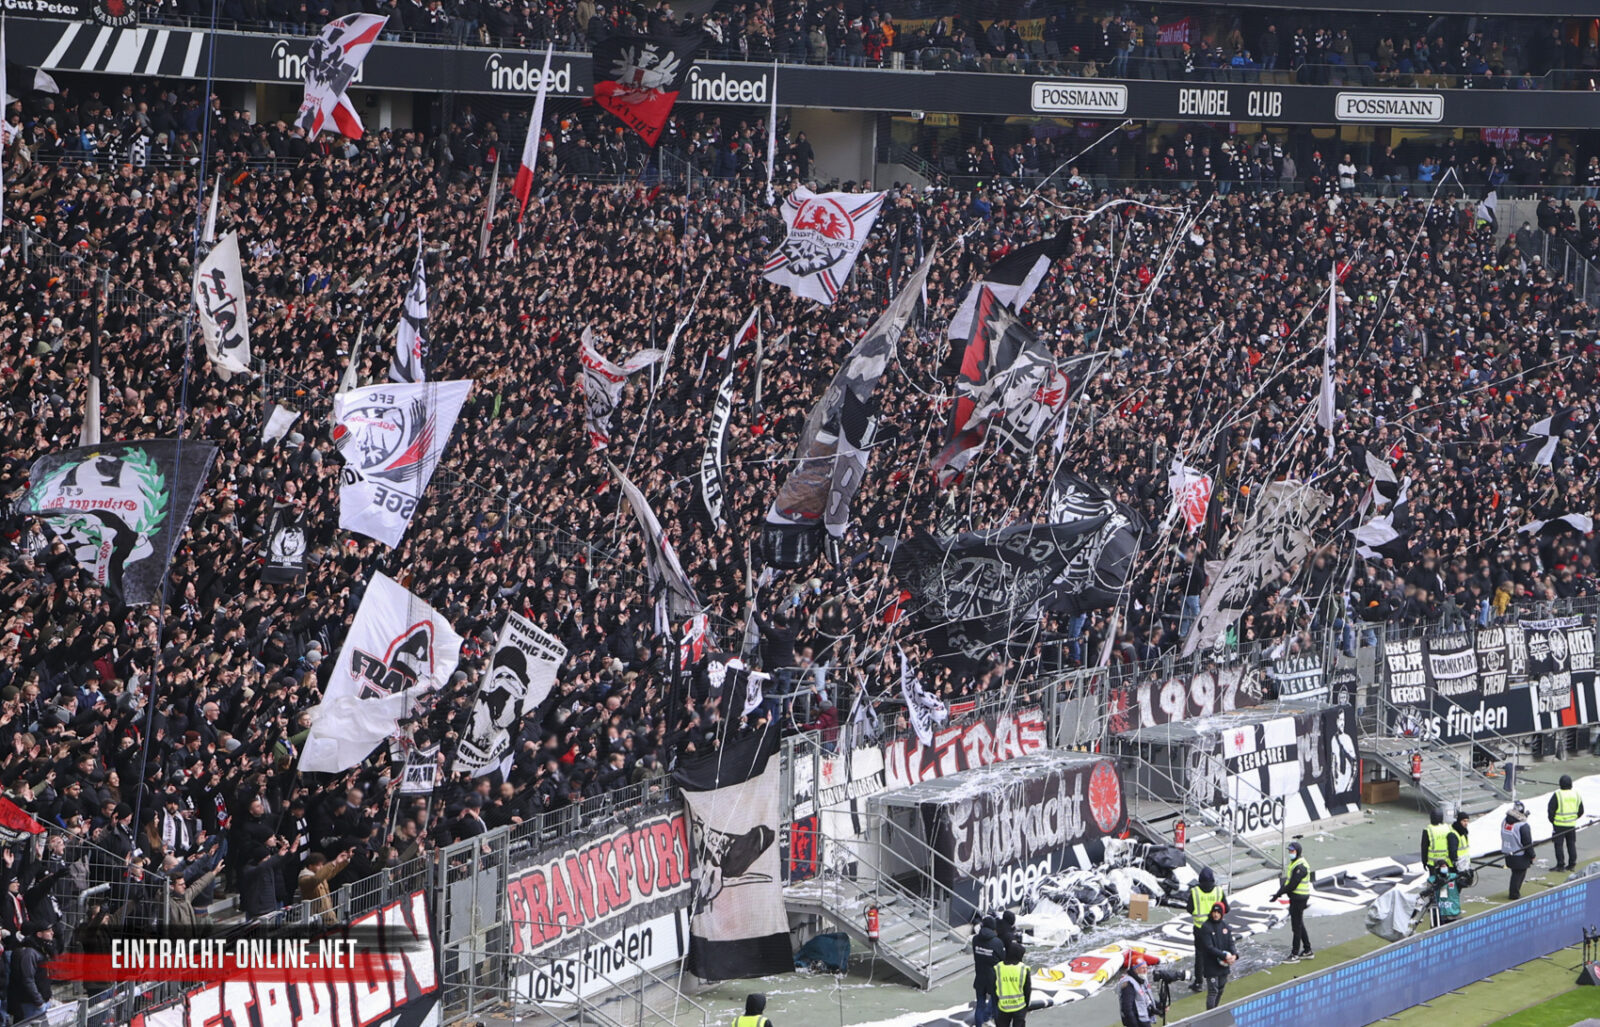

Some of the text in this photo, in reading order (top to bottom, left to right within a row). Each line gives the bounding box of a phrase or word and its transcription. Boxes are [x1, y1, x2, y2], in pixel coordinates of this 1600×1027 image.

[6, 0, 79, 15] Gut Peter
[491, 60, 571, 93] indeed
[691, 72, 767, 103] indeed
[1041, 89, 1118, 107] POSSMANN
[1178, 88, 1282, 118] BEMBEL CLUB
[1346, 99, 1433, 115] POSSMANN
[1477, 627, 1505, 648] FULDA
[1567, 629, 1595, 655] RIED
[1276, 654, 1320, 674] ULTRAS
[1432, 650, 1477, 675] FRANKFURT
[1570, 653, 1595, 671] GEBIET
[1137, 667, 1242, 728] 1997
[1282, 675, 1321, 695] NEVER
[1483, 673, 1507, 697] CREW
[1446, 700, 1508, 738] finden
[885, 704, 1048, 790] ULTRAS
[951, 772, 1086, 878] Eintracht
[508, 816, 691, 955] FRANKFURT
[584, 924, 653, 984] finden
